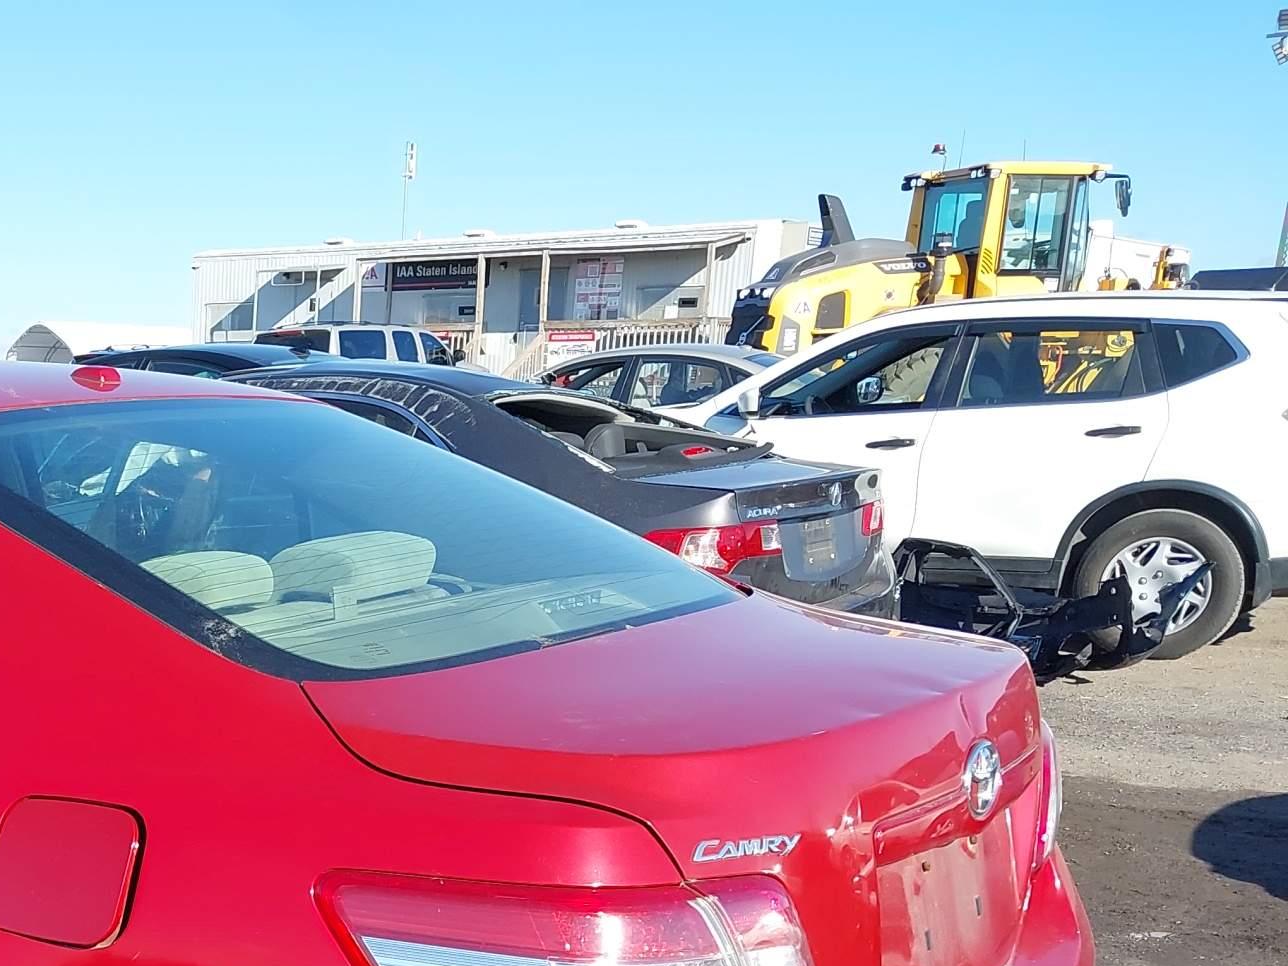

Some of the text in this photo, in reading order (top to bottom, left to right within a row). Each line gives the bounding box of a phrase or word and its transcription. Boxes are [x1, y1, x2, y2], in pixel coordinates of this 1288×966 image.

[396, 265, 414, 278] IAA
[416, 263, 446, 277] Staten
[880, 261, 927, 271] VOLVO
[747, 507, 780, 519] ACURA
[692, 832, 802, 862] CAMRY
